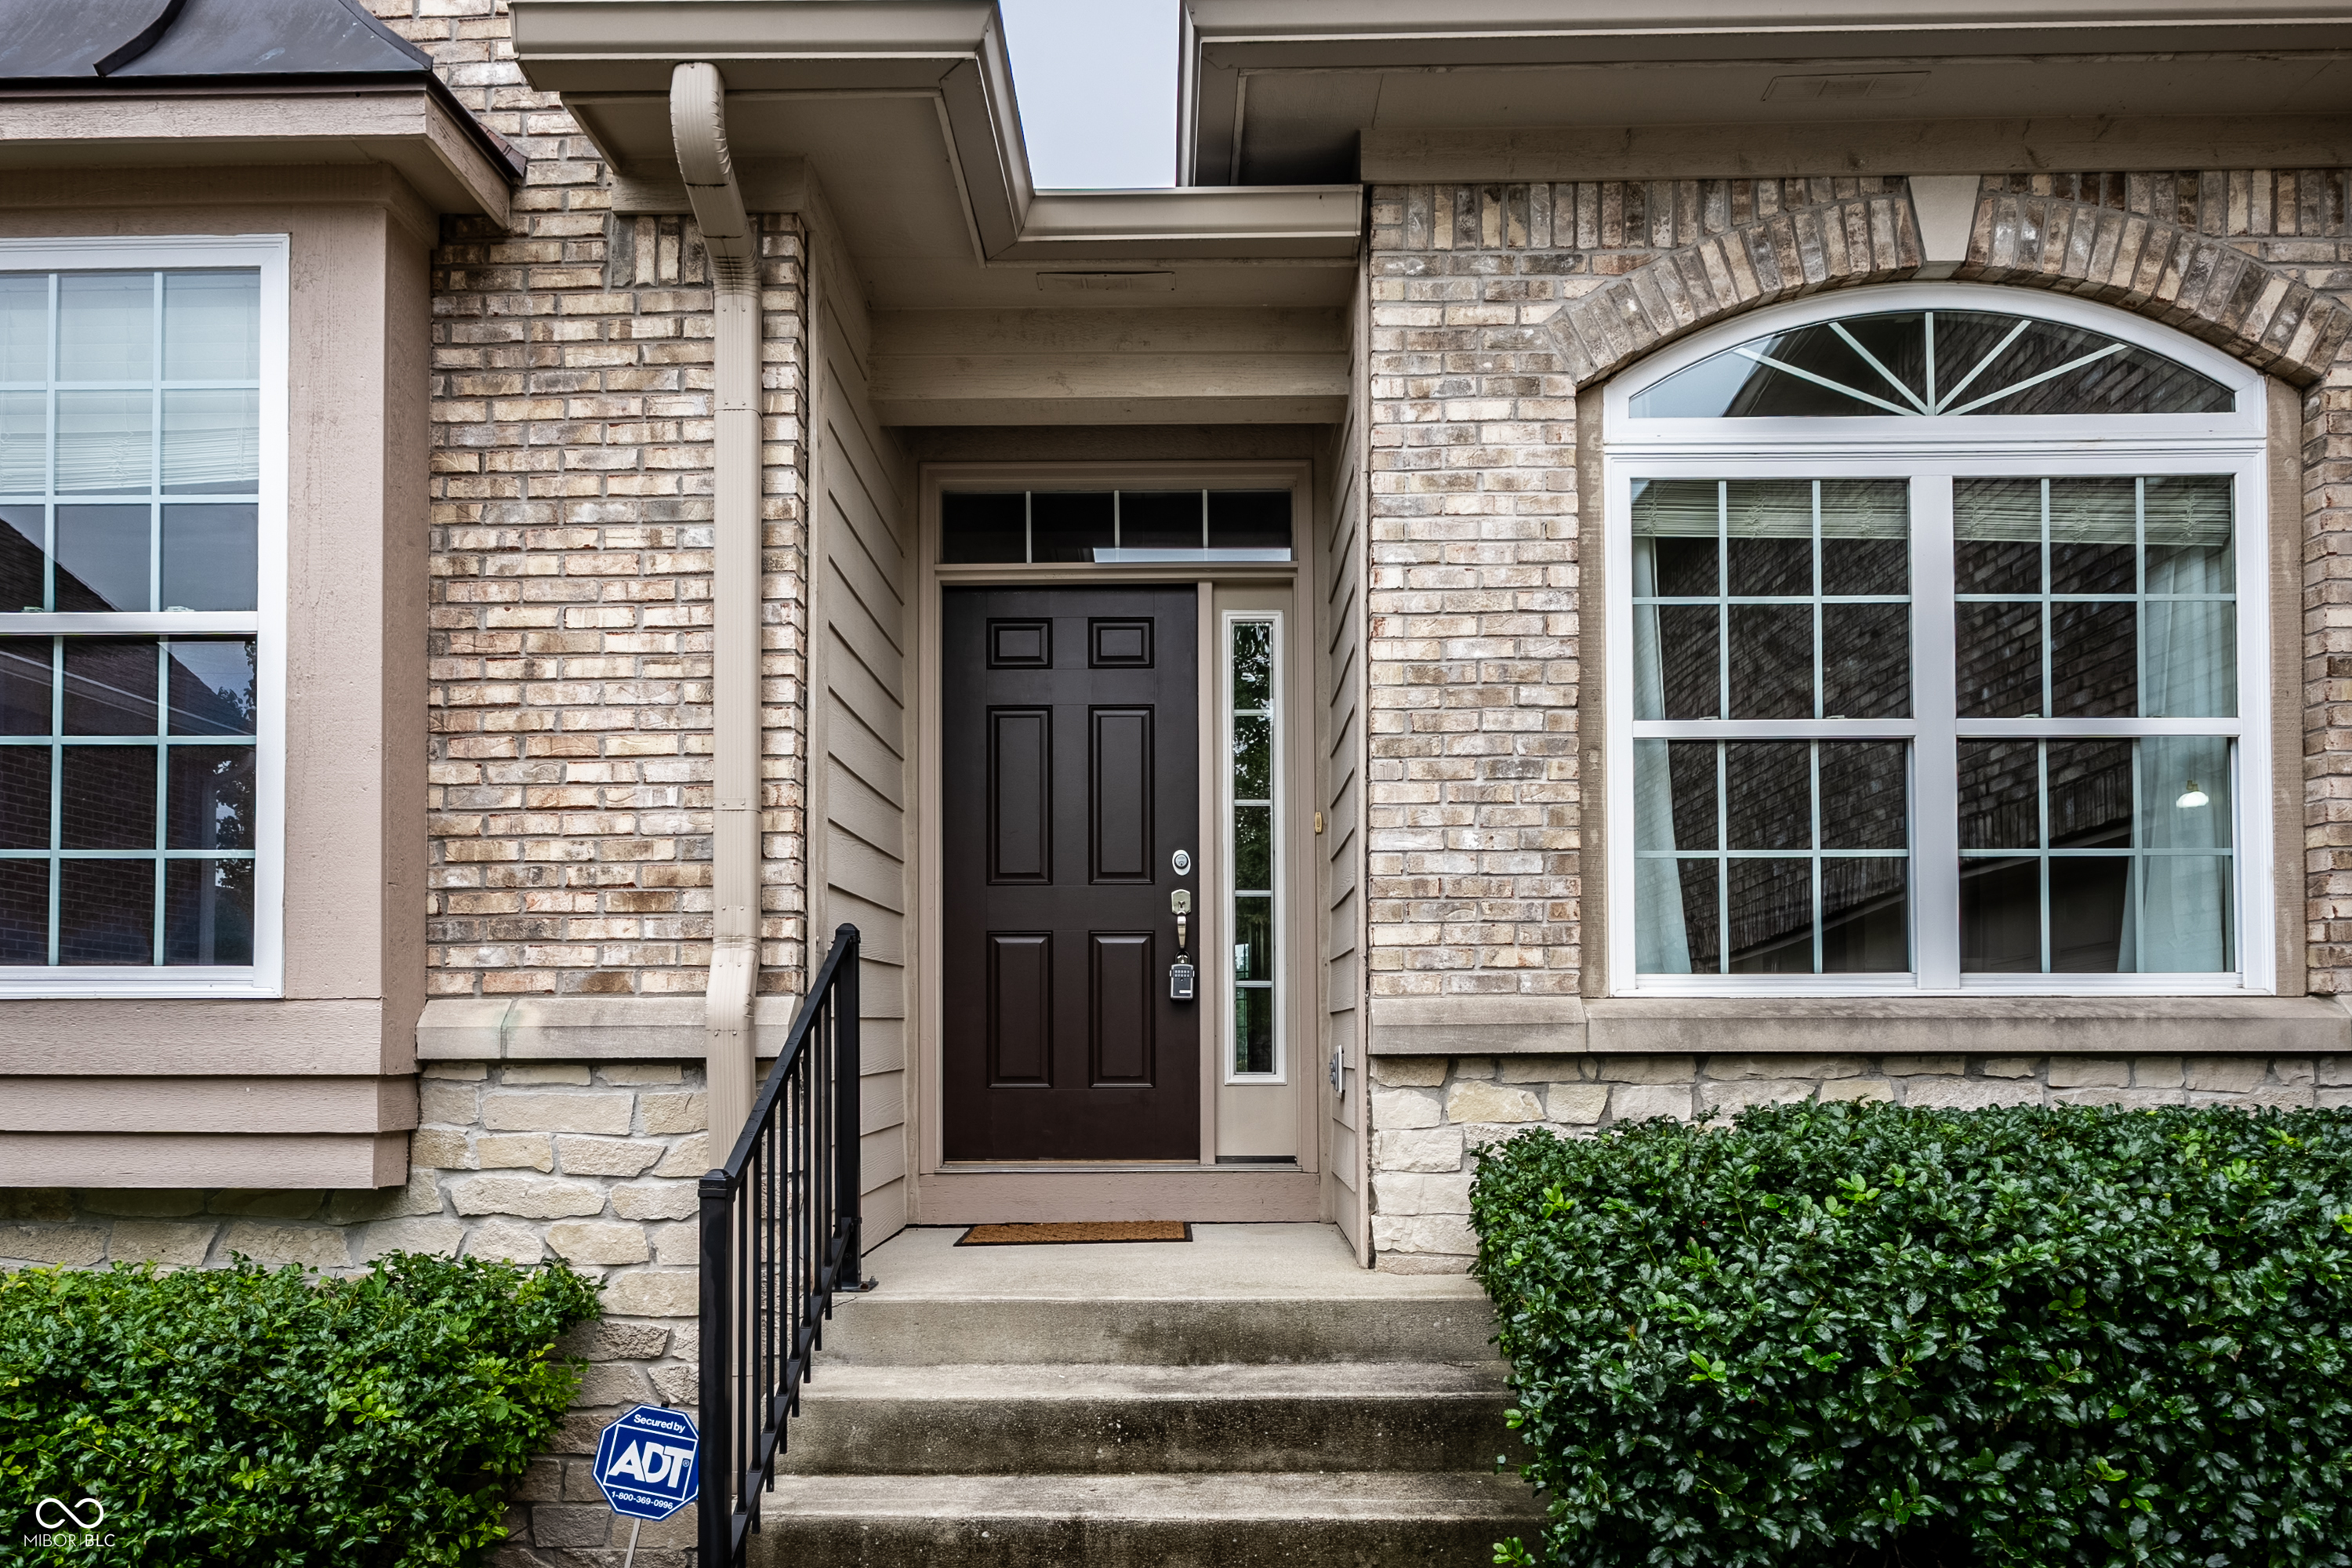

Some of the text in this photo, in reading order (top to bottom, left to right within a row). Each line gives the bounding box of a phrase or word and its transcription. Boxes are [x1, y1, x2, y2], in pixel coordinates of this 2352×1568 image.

[633, 1414, 686, 1434] Secured by
[608, 1439, 694, 1488] ADT
[612, 1491, 673, 1509] 1-800-369-0996
